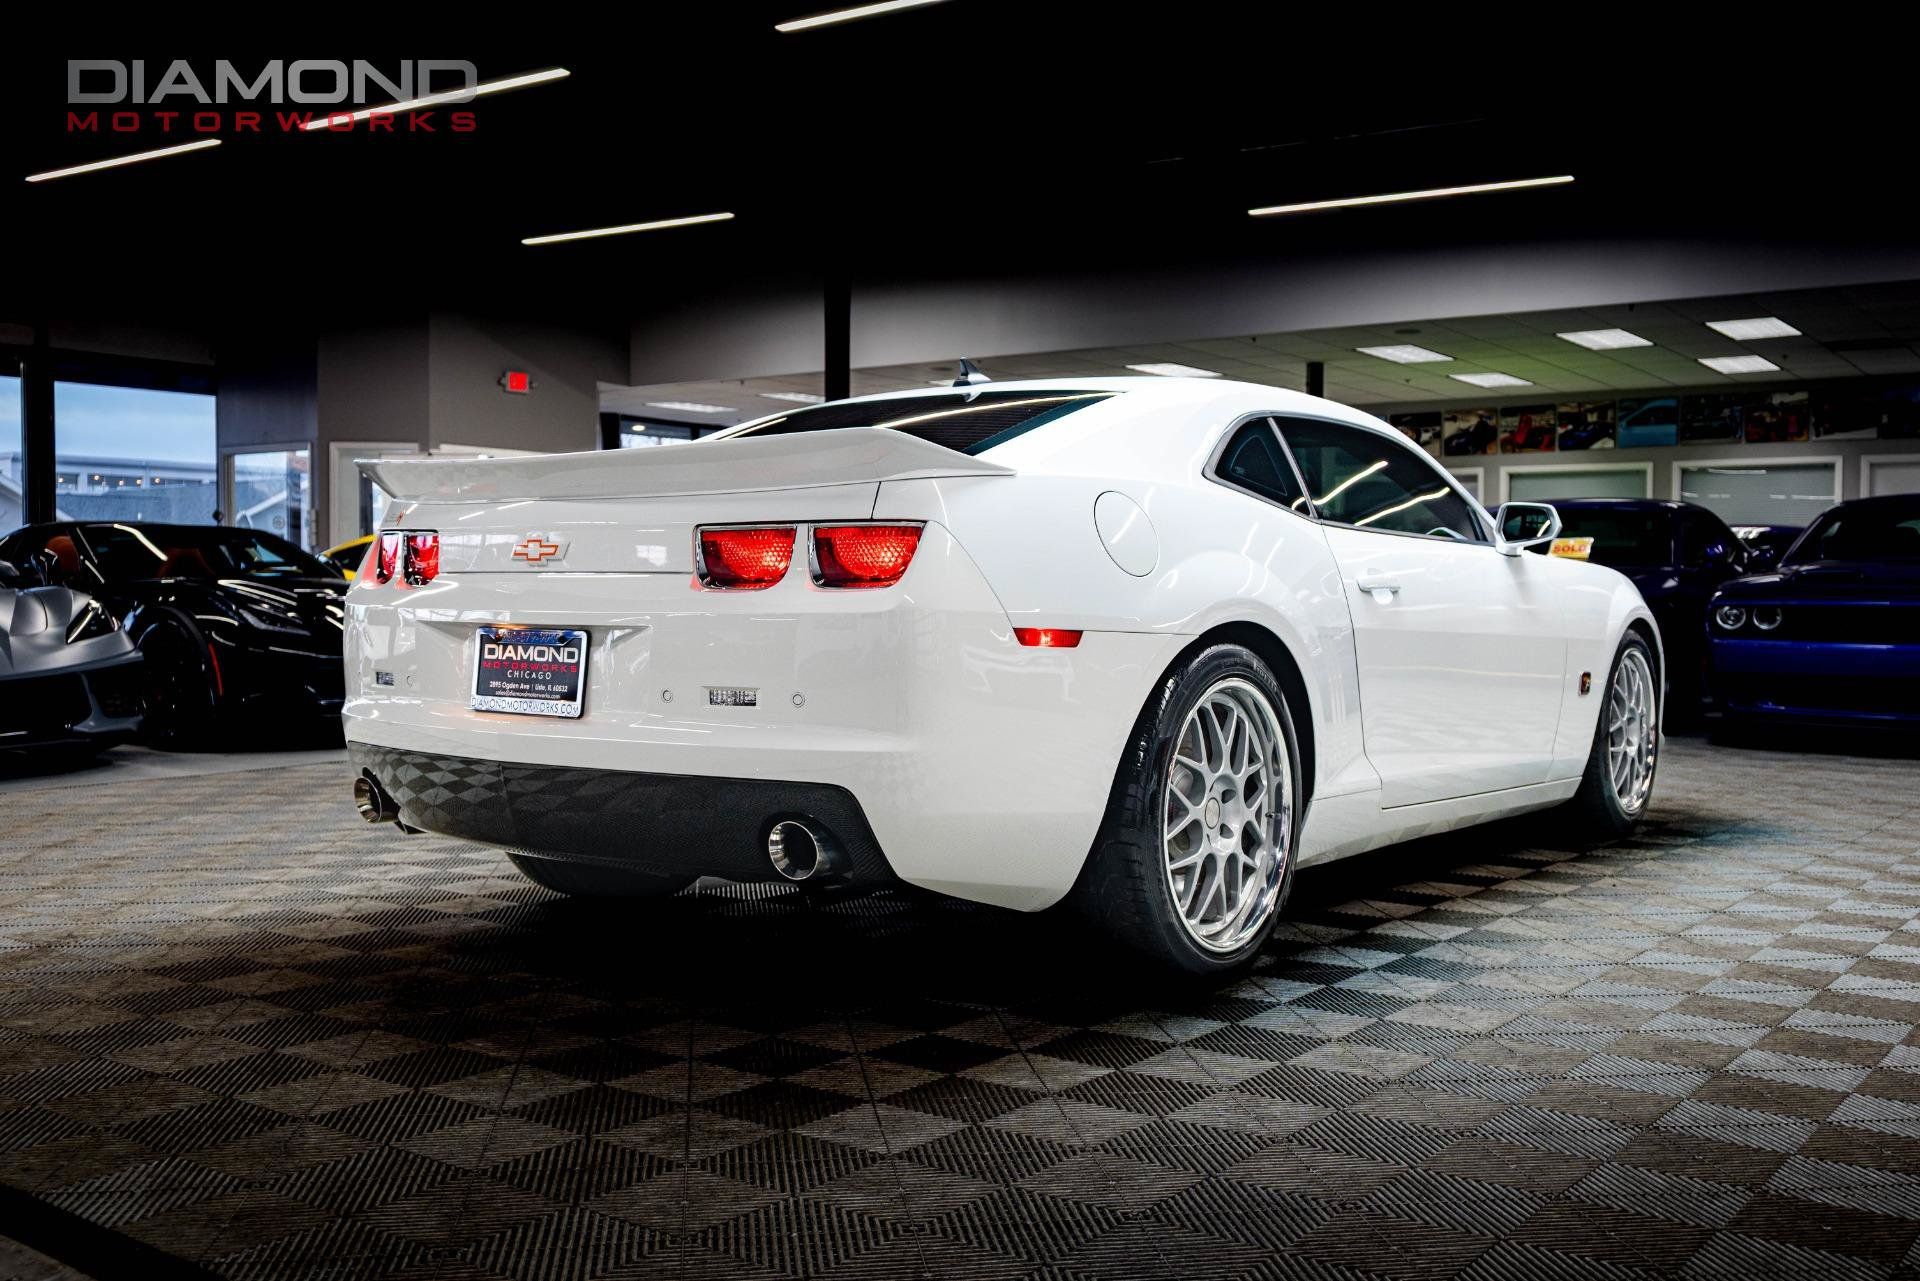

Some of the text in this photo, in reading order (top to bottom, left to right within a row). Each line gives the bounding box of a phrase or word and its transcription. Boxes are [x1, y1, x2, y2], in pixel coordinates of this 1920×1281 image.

[1553, 543, 1587, 553] SOLD
[484, 643, 579, 663] DIAMOND
[483, 661, 577, 673] MOTORWORKS
[507, 670, 552, 680] CHICAGO
[501, 682, 519, 690] Ogden
